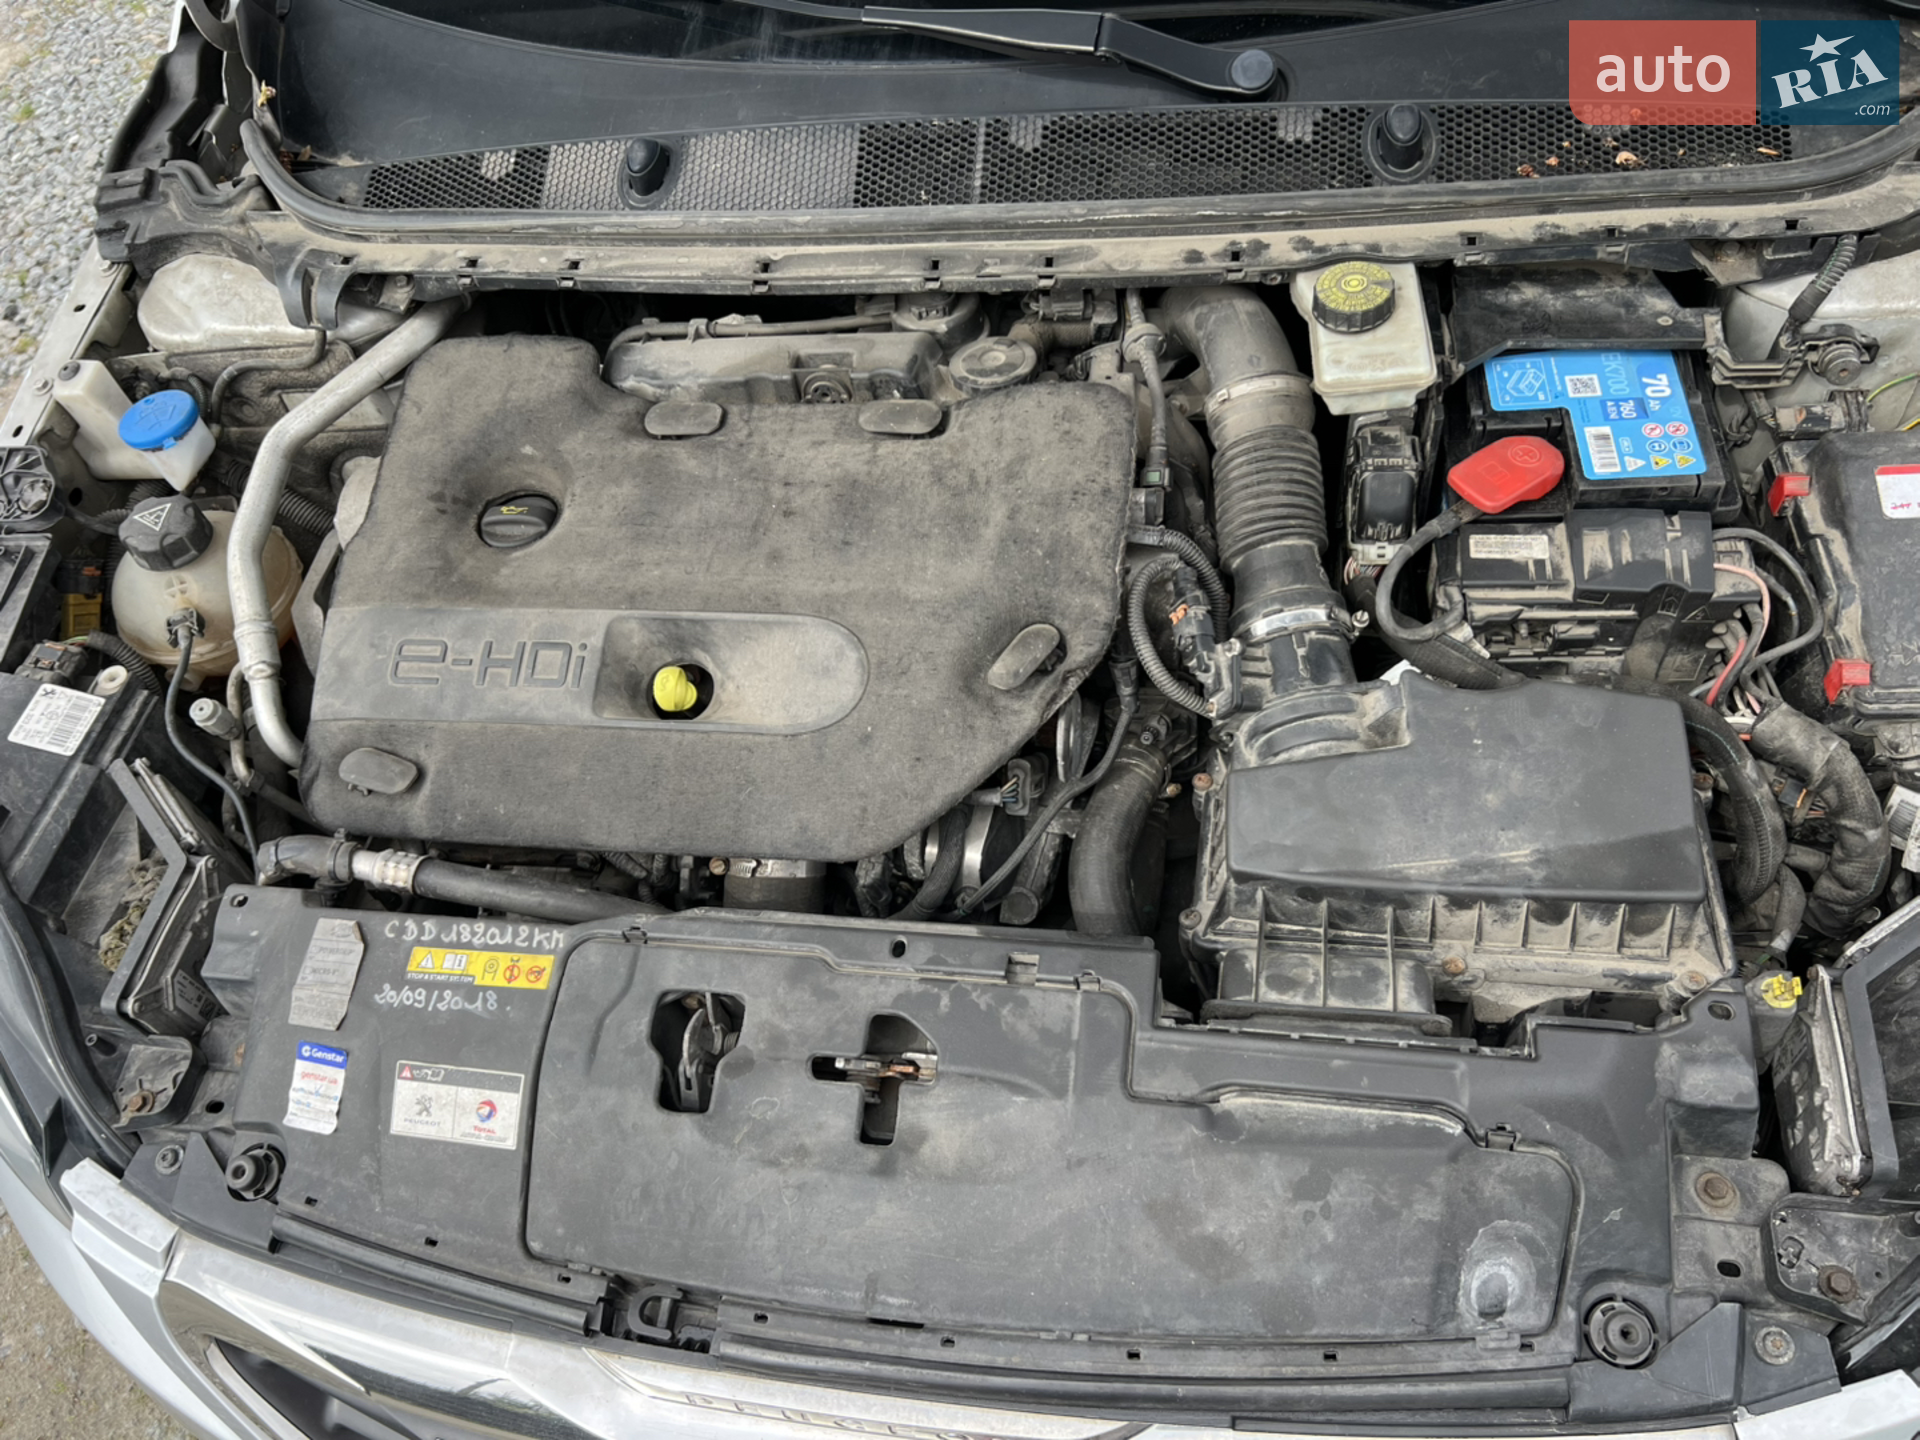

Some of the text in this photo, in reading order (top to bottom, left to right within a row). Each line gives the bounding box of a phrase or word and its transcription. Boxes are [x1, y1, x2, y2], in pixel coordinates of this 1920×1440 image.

[1601, 353, 1629, 395] EK700
[1641, 373, 1672, 397] 70
[1618, 399, 1637, 419] 760
[407, 972, 424, 980] STOP
[311, 1047, 345, 1064] Genstar
[403, 1116, 442, 1127] PEUGEOT
[473, 1124, 497, 1135] TOTAL
